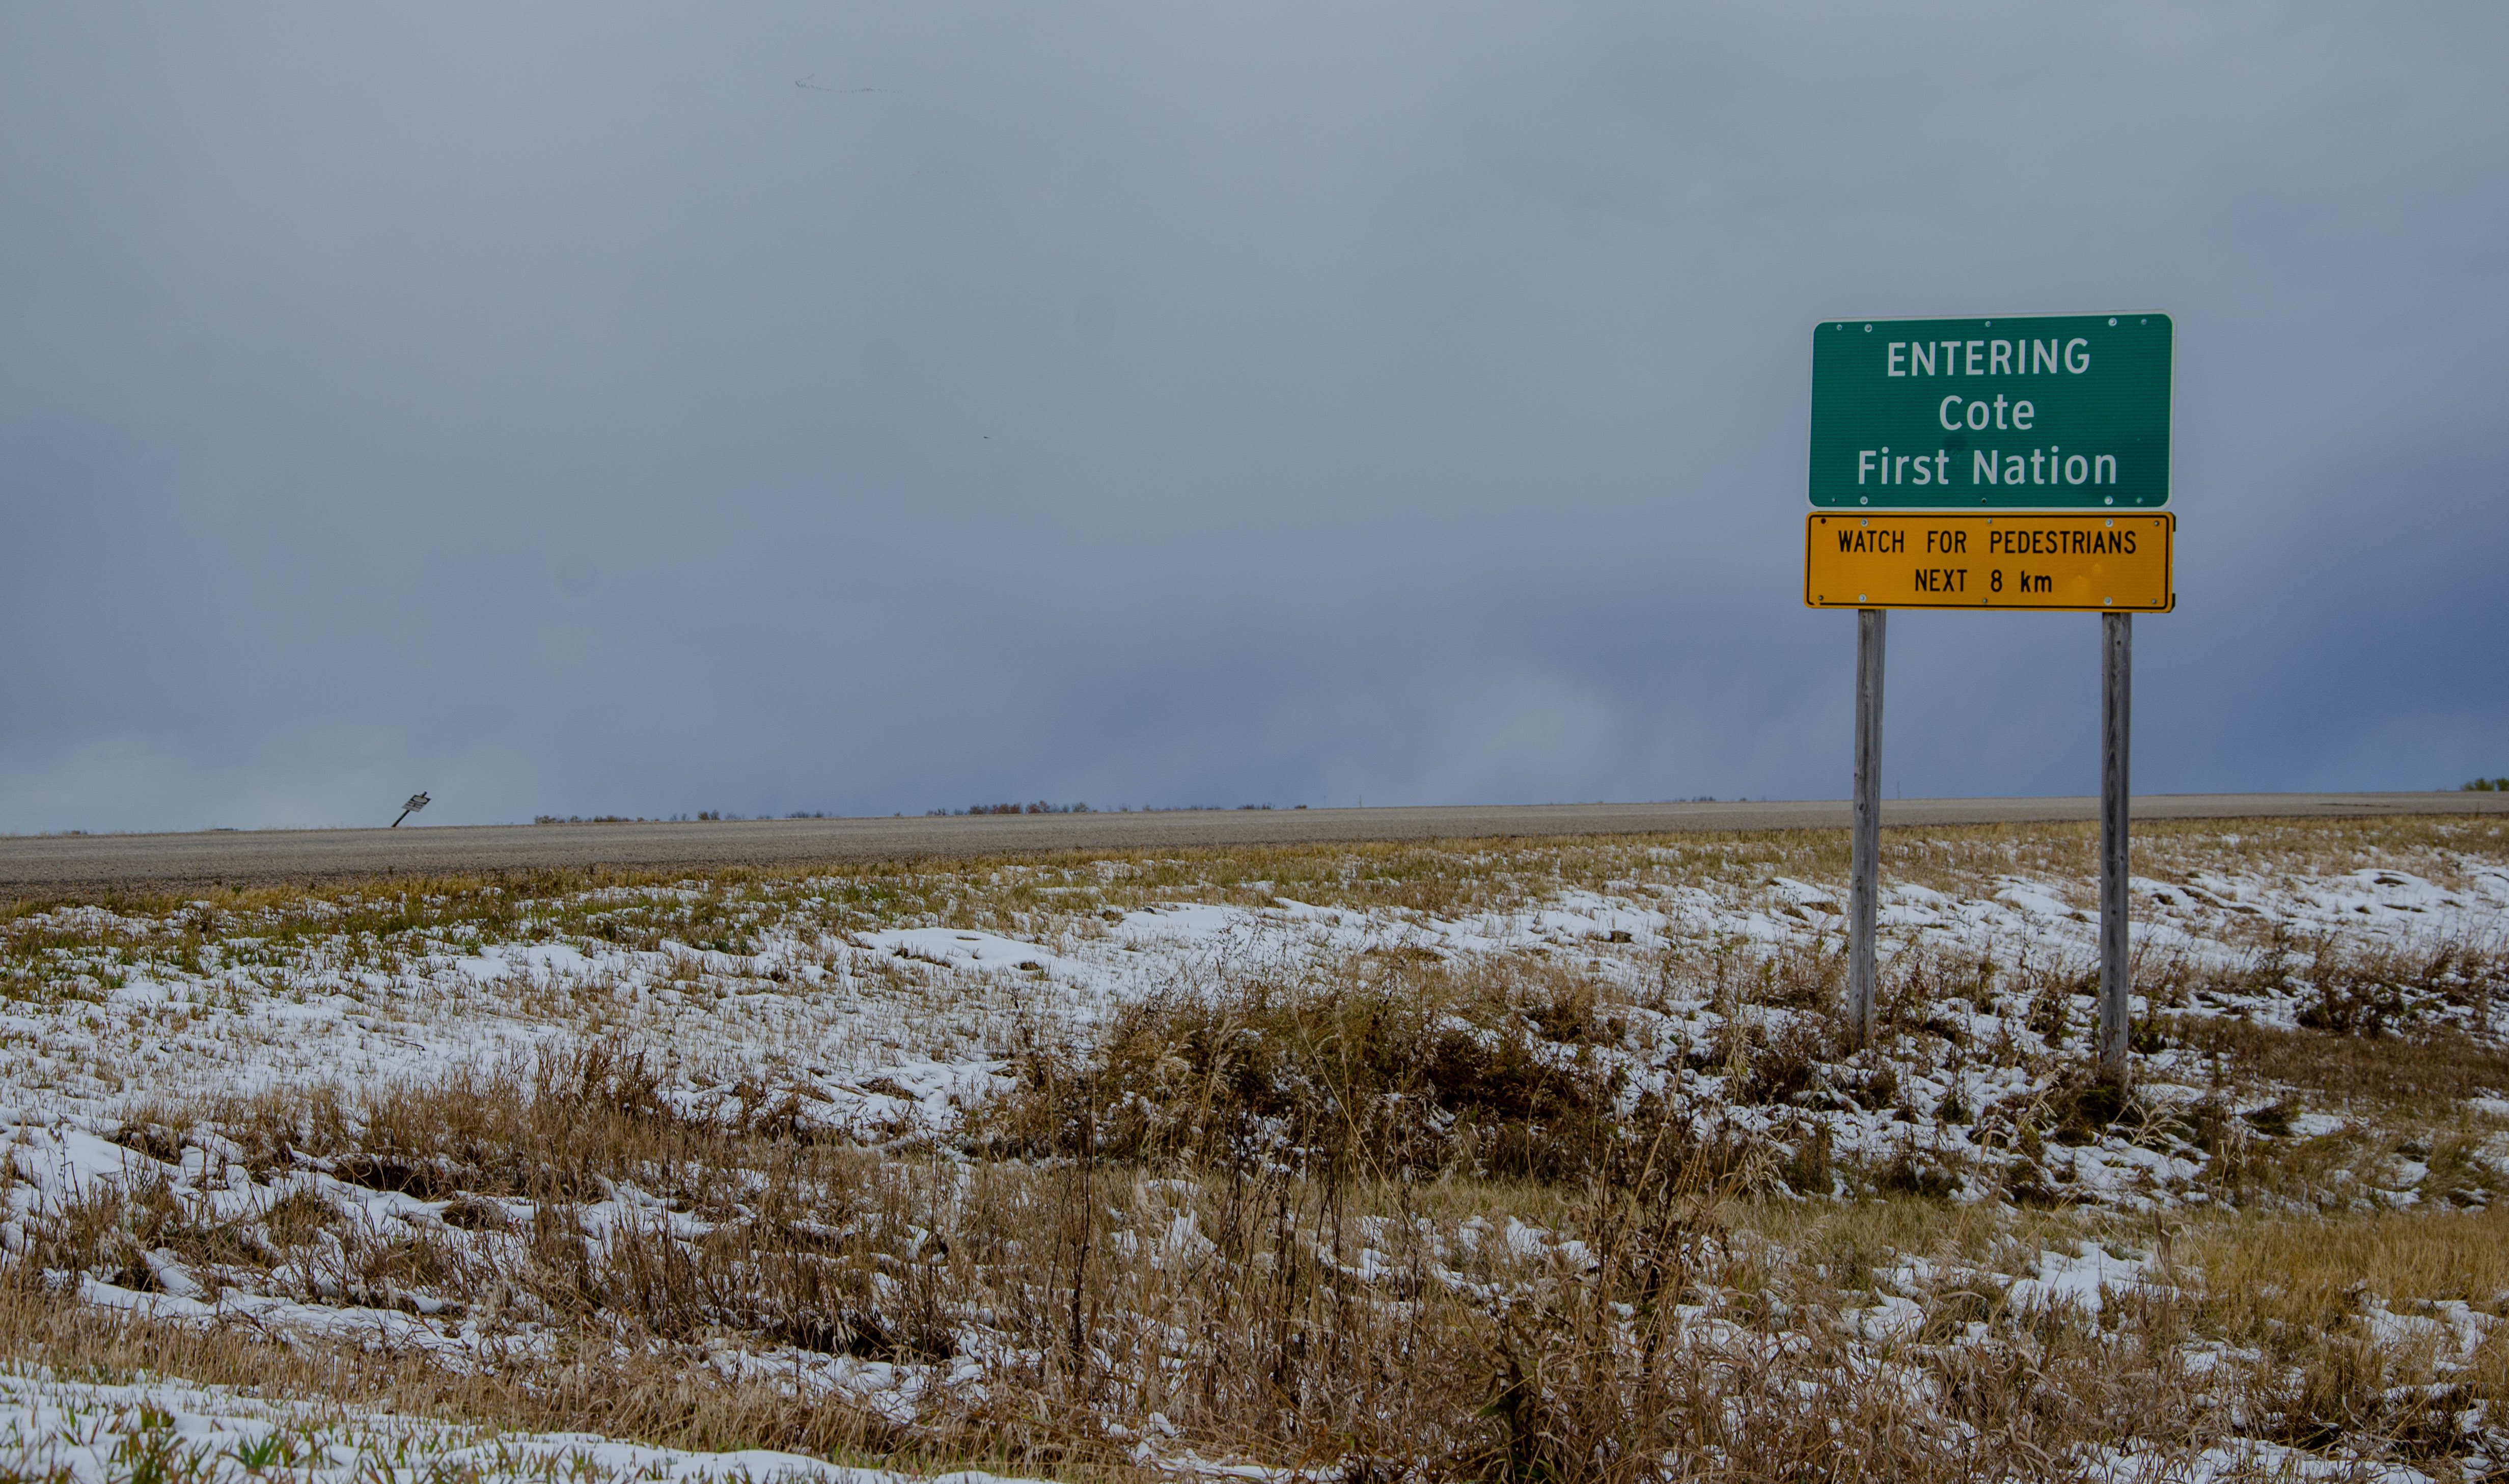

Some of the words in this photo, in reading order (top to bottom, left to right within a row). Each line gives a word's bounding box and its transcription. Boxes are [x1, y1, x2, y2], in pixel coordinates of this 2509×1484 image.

[1888, 338, 2090, 377] ENTERING
[1939, 394, 2034, 431] Cote
[1858, 447, 1949, 485] First
[1973, 446, 2116, 485] Nation
[1838, 530, 1904, 553] WATCH
[1927, 530, 1967, 554] FOR
[1990, 530, 2136, 555] PEDESTRIANS
[1915, 569, 1968, 592] NEXT
[1991, 569, 2002, 592] 8
[2021, 570, 2052, 593] km
